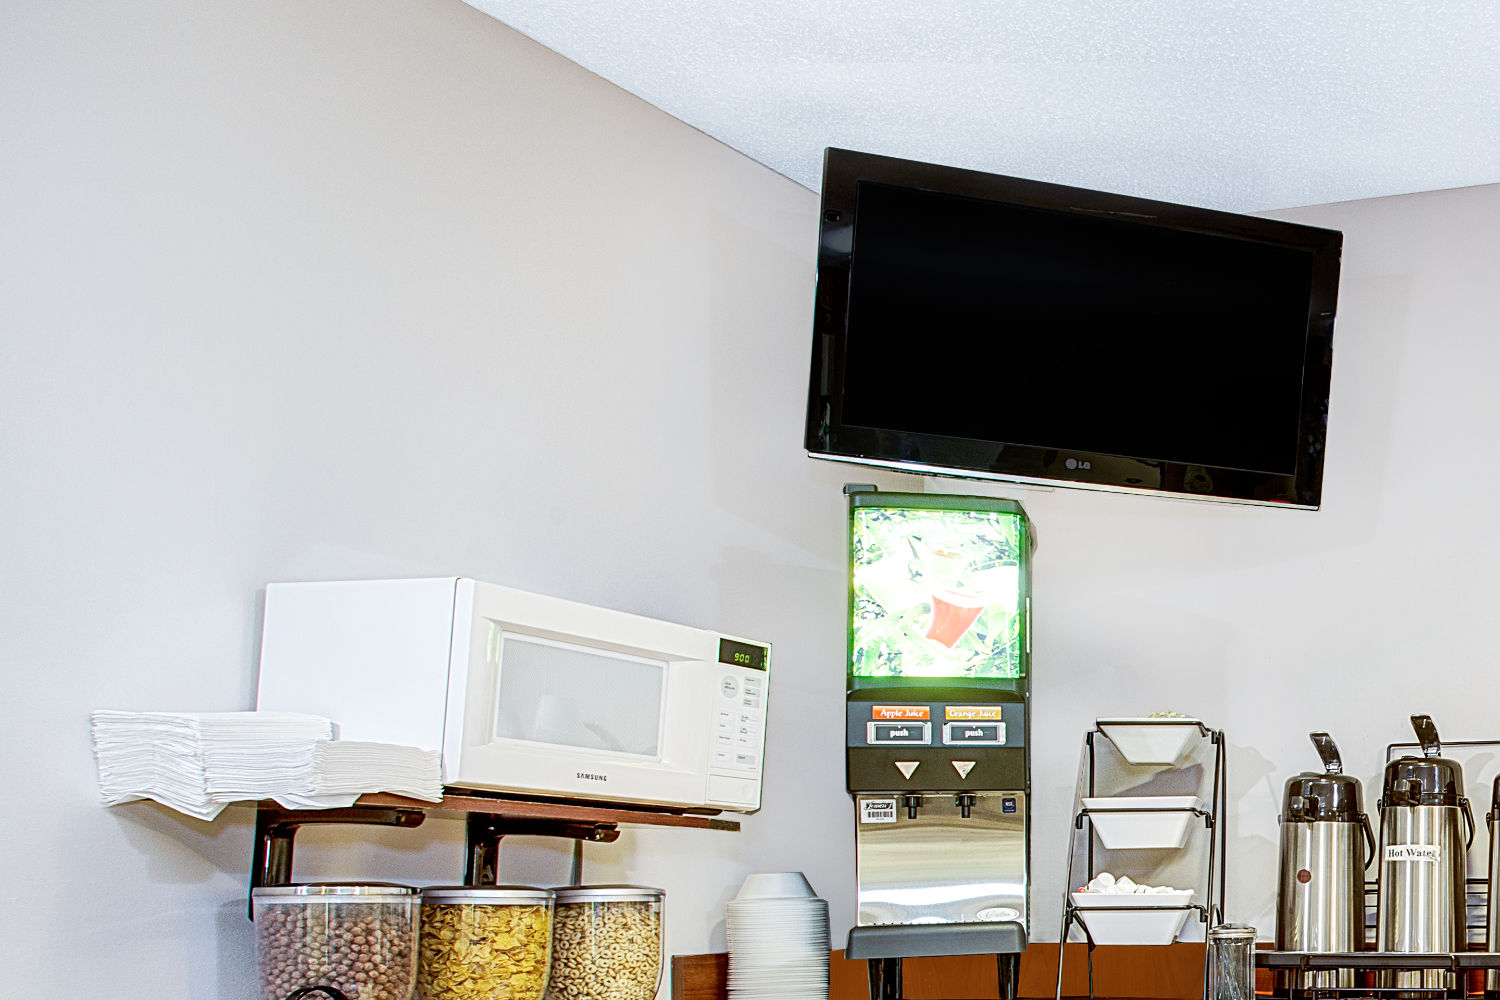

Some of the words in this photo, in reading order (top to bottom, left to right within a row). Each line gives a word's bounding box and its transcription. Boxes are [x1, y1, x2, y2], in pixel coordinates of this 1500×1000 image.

[880, 708, 903, 718] Apple
[905, 708, 924, 717] Juice
[948, 709, 976, 719] Orange
[978, 709, 997, 717] Juice
[889, 729, 908, 738] push
[964, 729, 983, 738] push
[576, 771, 608, 782] SAMSUNG
[1388, 849, 1403, 858] Hot
